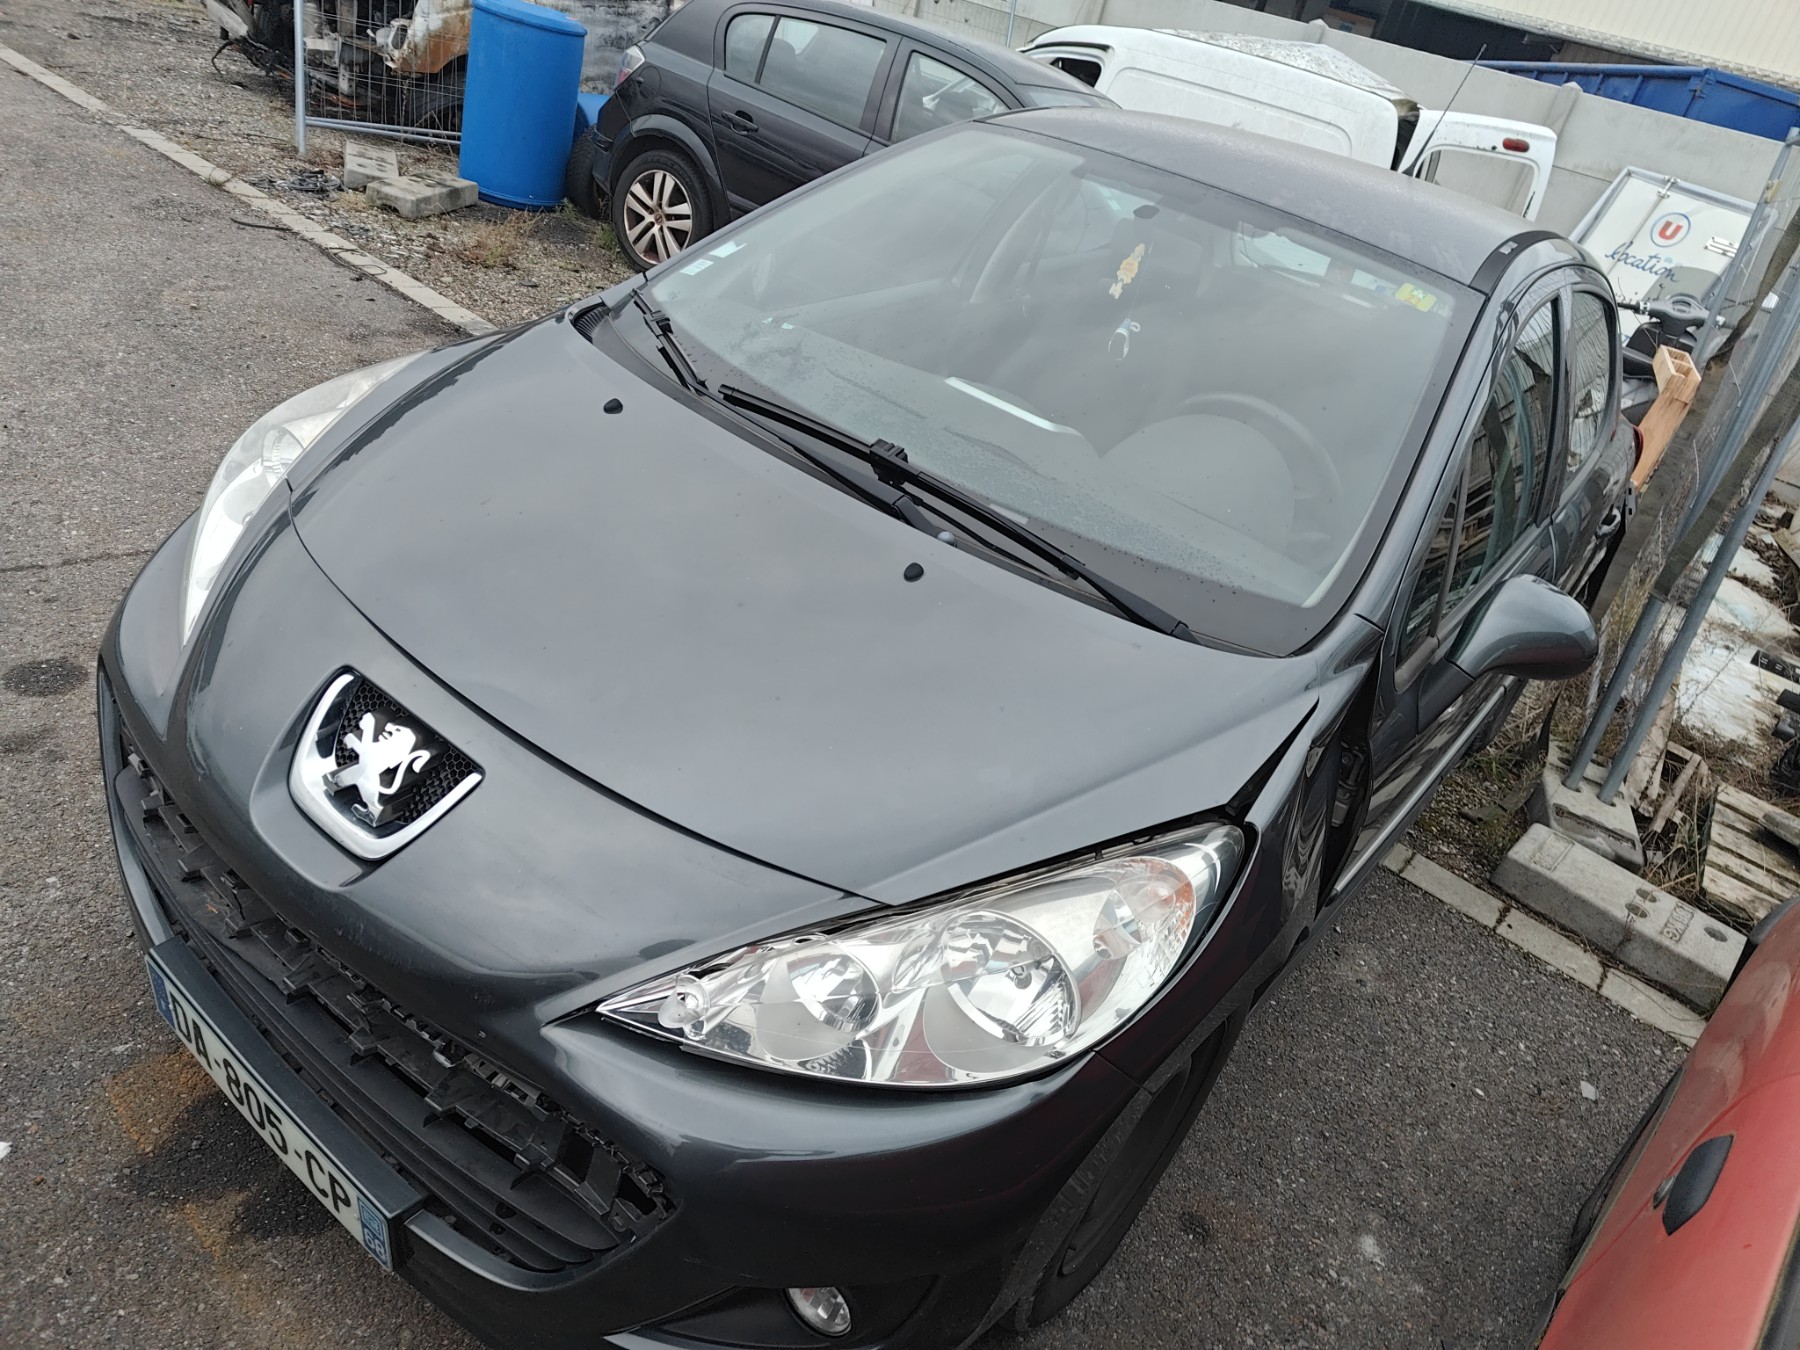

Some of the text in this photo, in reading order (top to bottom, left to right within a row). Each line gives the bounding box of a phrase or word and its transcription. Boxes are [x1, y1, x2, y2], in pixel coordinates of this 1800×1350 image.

[1658, 220, 1683, 241] U
[1604, 241, 1680, 282] location
[169, 990, 352, 1213] DA-805-CP
[364, 1228, 387, 1261] 68
